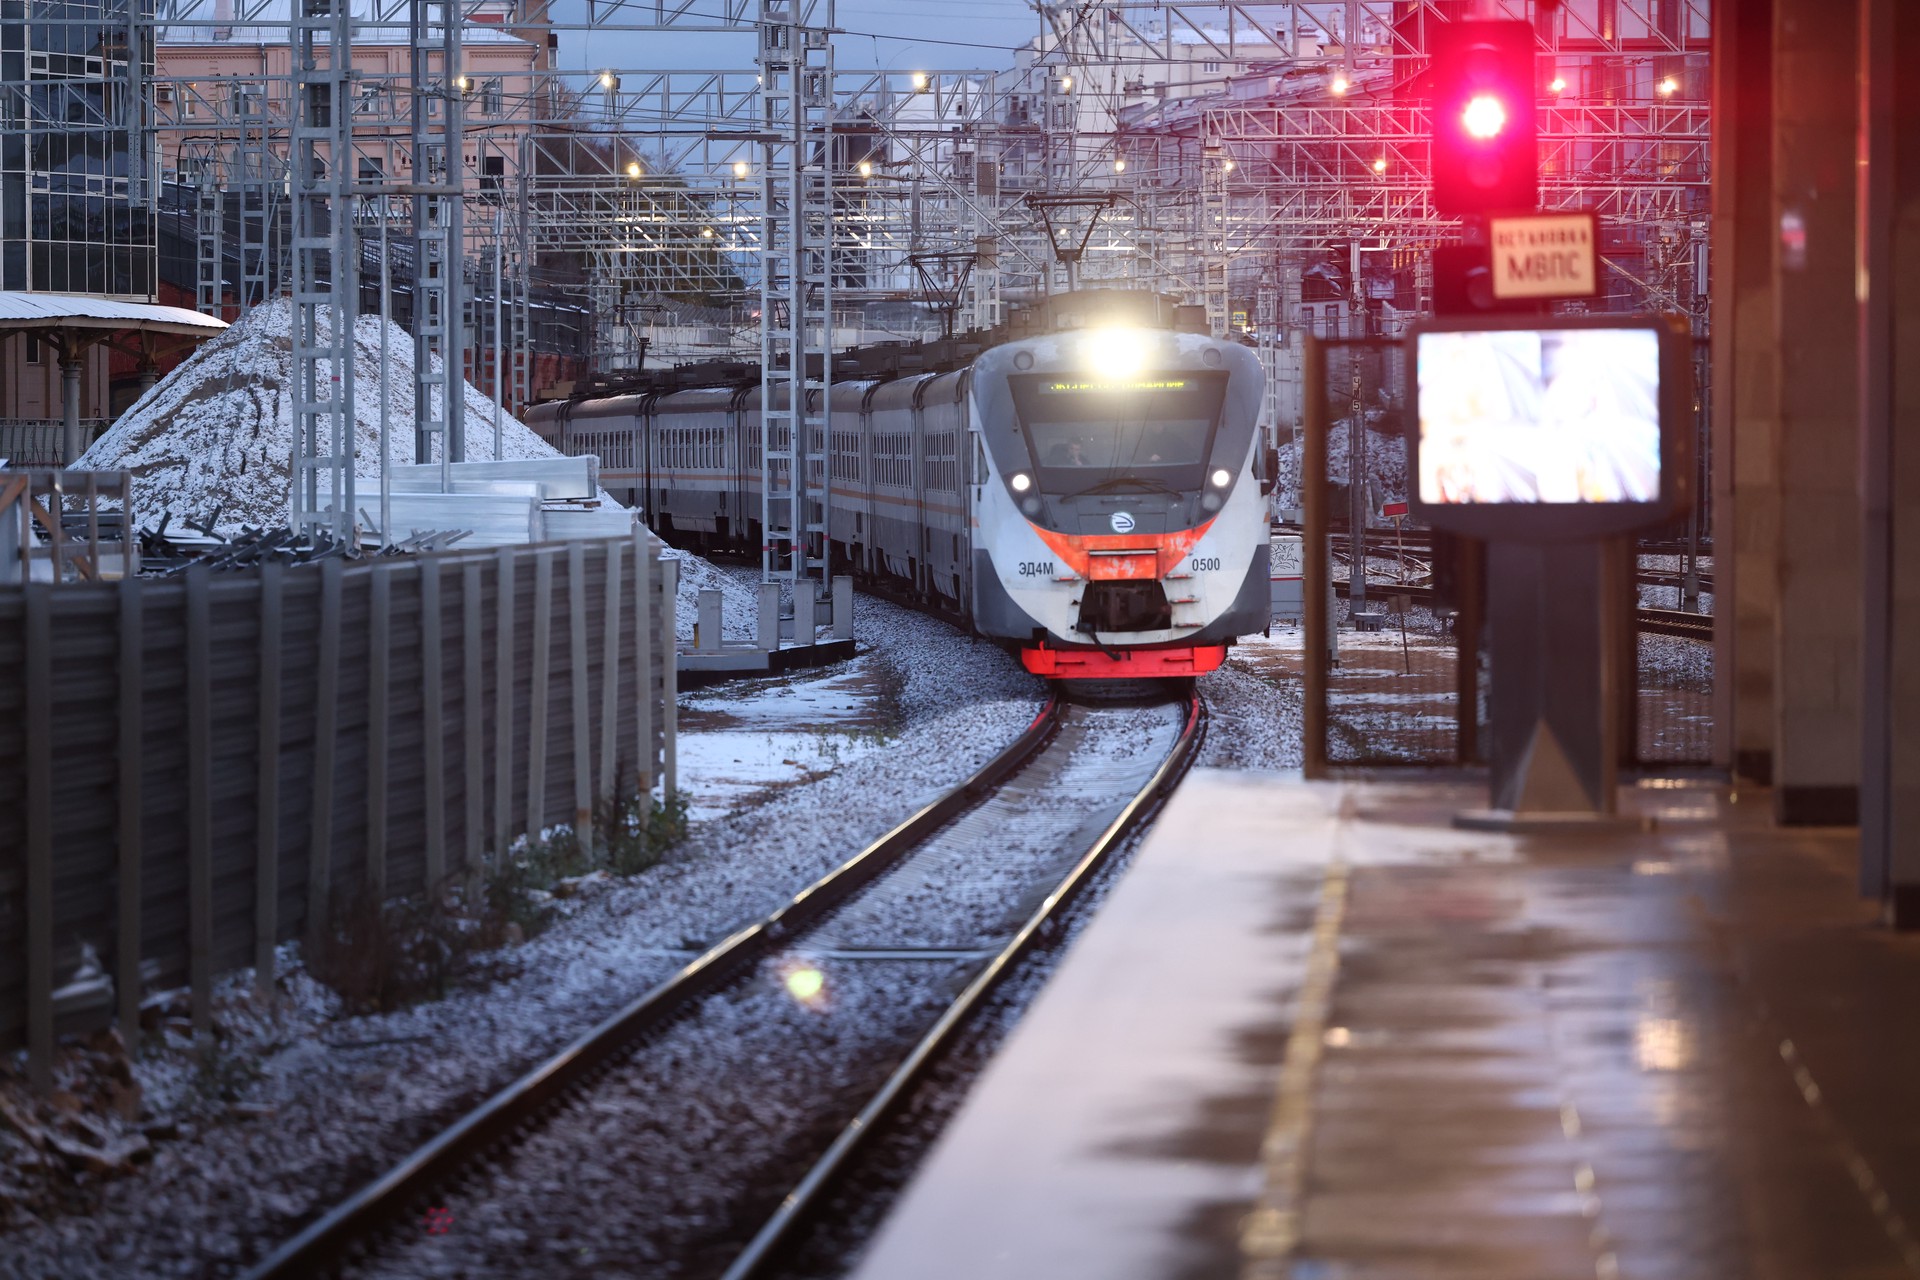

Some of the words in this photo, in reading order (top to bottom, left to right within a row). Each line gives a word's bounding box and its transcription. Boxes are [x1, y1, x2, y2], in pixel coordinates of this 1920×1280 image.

[1507, 251, 1580, 281] МВПС
[1018, 562, 1054, 576] ЭД4М
[1191, 558, 1220, 571] 0500
